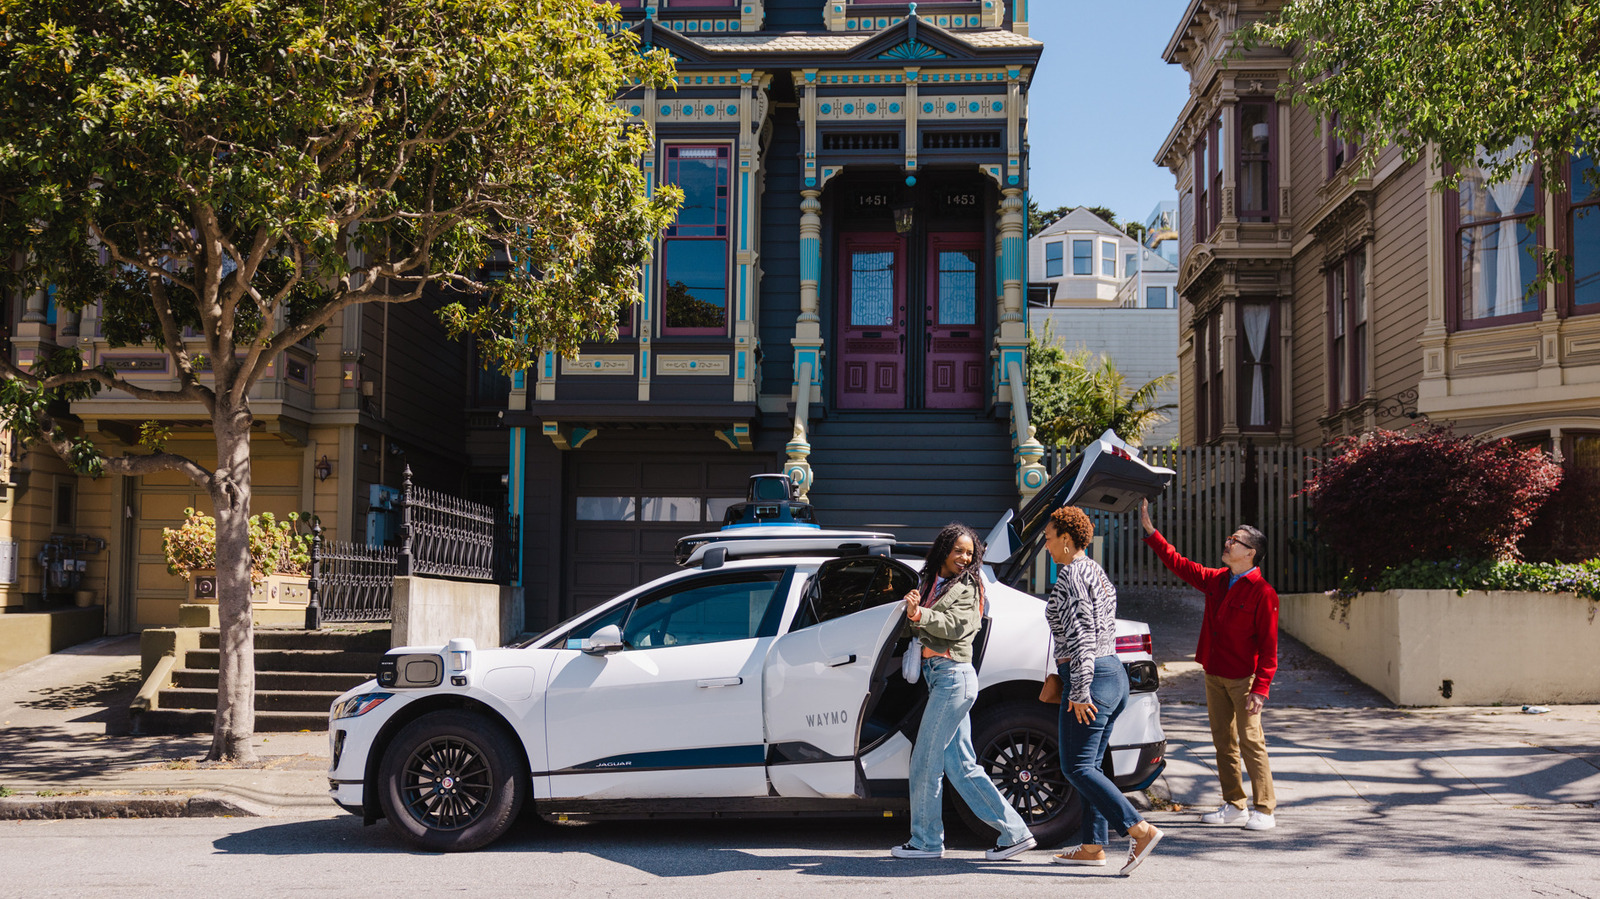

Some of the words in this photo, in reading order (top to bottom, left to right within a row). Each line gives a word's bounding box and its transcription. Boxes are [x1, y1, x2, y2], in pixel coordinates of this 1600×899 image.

[859, 195, 887, 206] 1451
[947, 194, 976, 205] 1453
[805, 709, 848, 728] WAYMO
